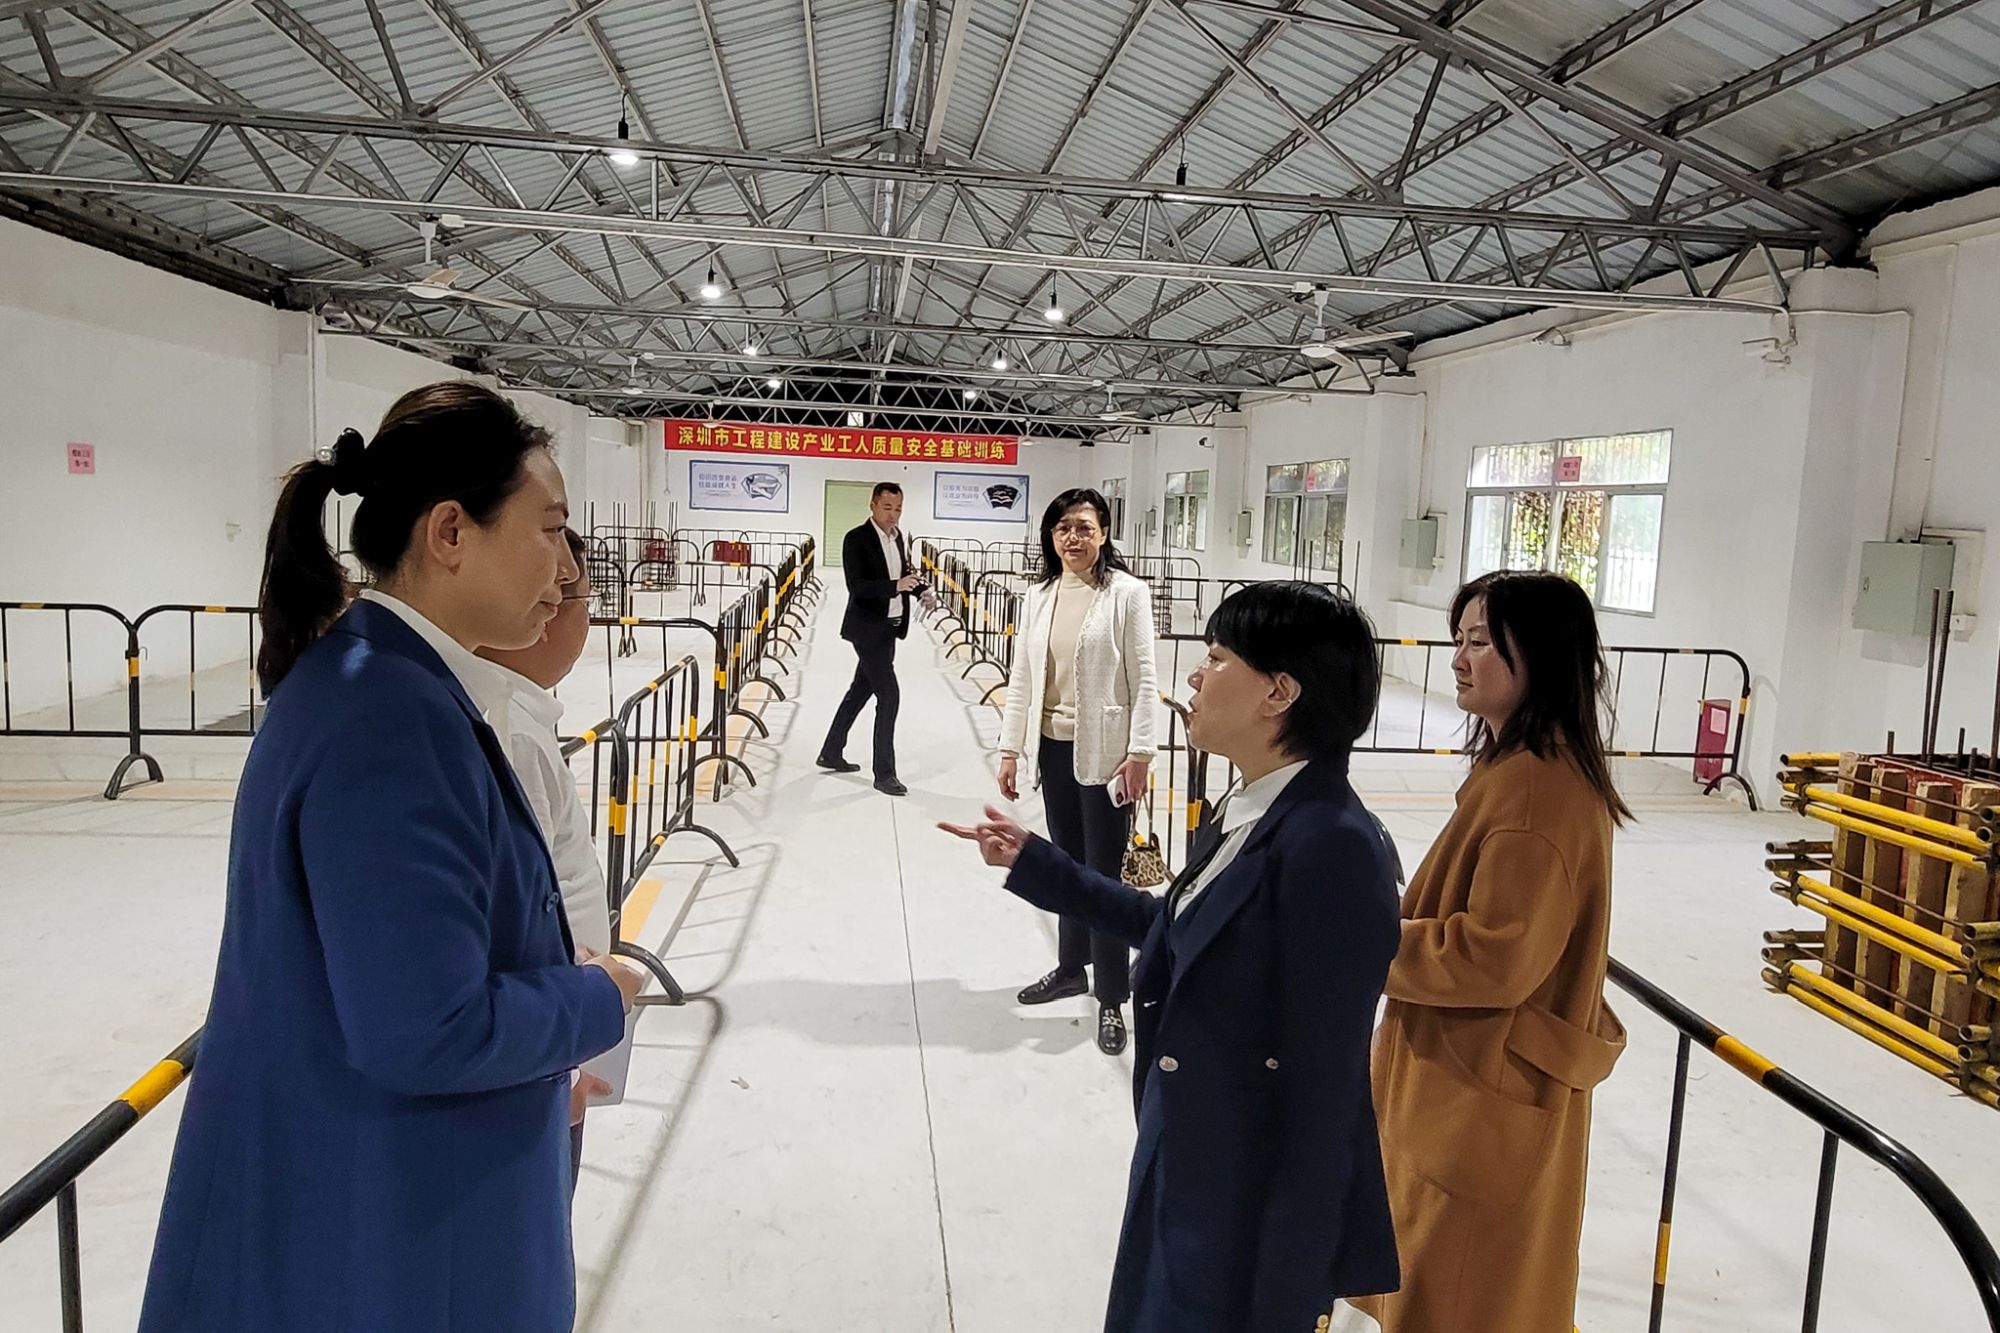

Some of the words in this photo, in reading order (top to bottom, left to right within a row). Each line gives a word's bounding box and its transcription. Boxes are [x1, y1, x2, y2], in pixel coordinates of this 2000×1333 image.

[678, 425, 1005, 460] 深圳市工程建设产业工人质量安全基础训练
